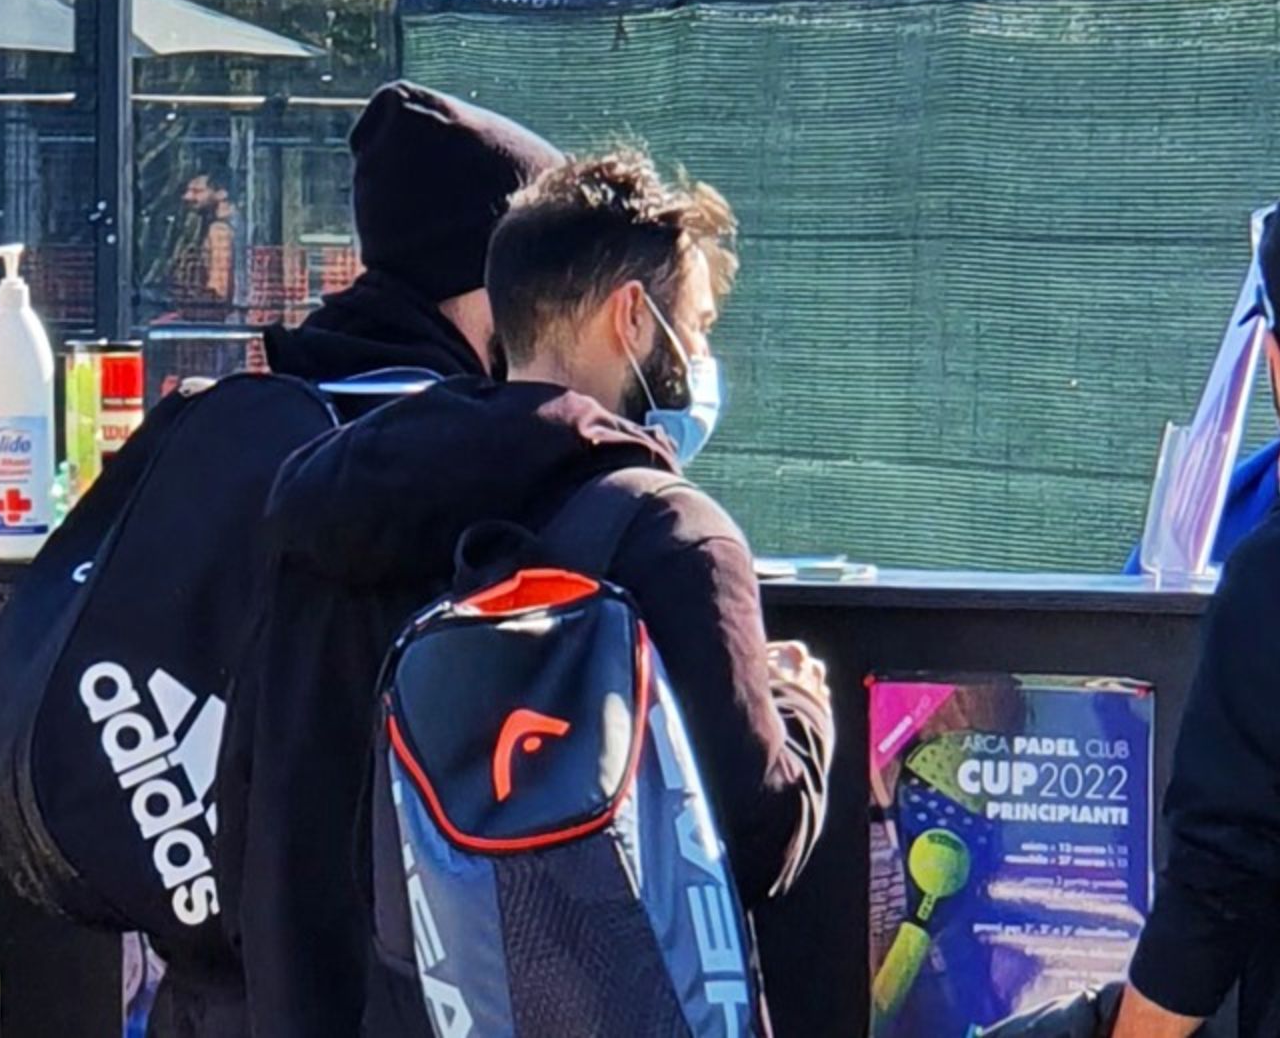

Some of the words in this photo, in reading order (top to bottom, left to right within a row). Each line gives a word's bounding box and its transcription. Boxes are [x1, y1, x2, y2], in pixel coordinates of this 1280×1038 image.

[961, 734, 1010, 753] ARCA
[1013, 736, 1080, 757] PADEL
[1085, 739, 1130, 759] CLUB
[79, 661, 220, 925] adidas
[986, 801, 1129, 825] PRINCIPIANTI
